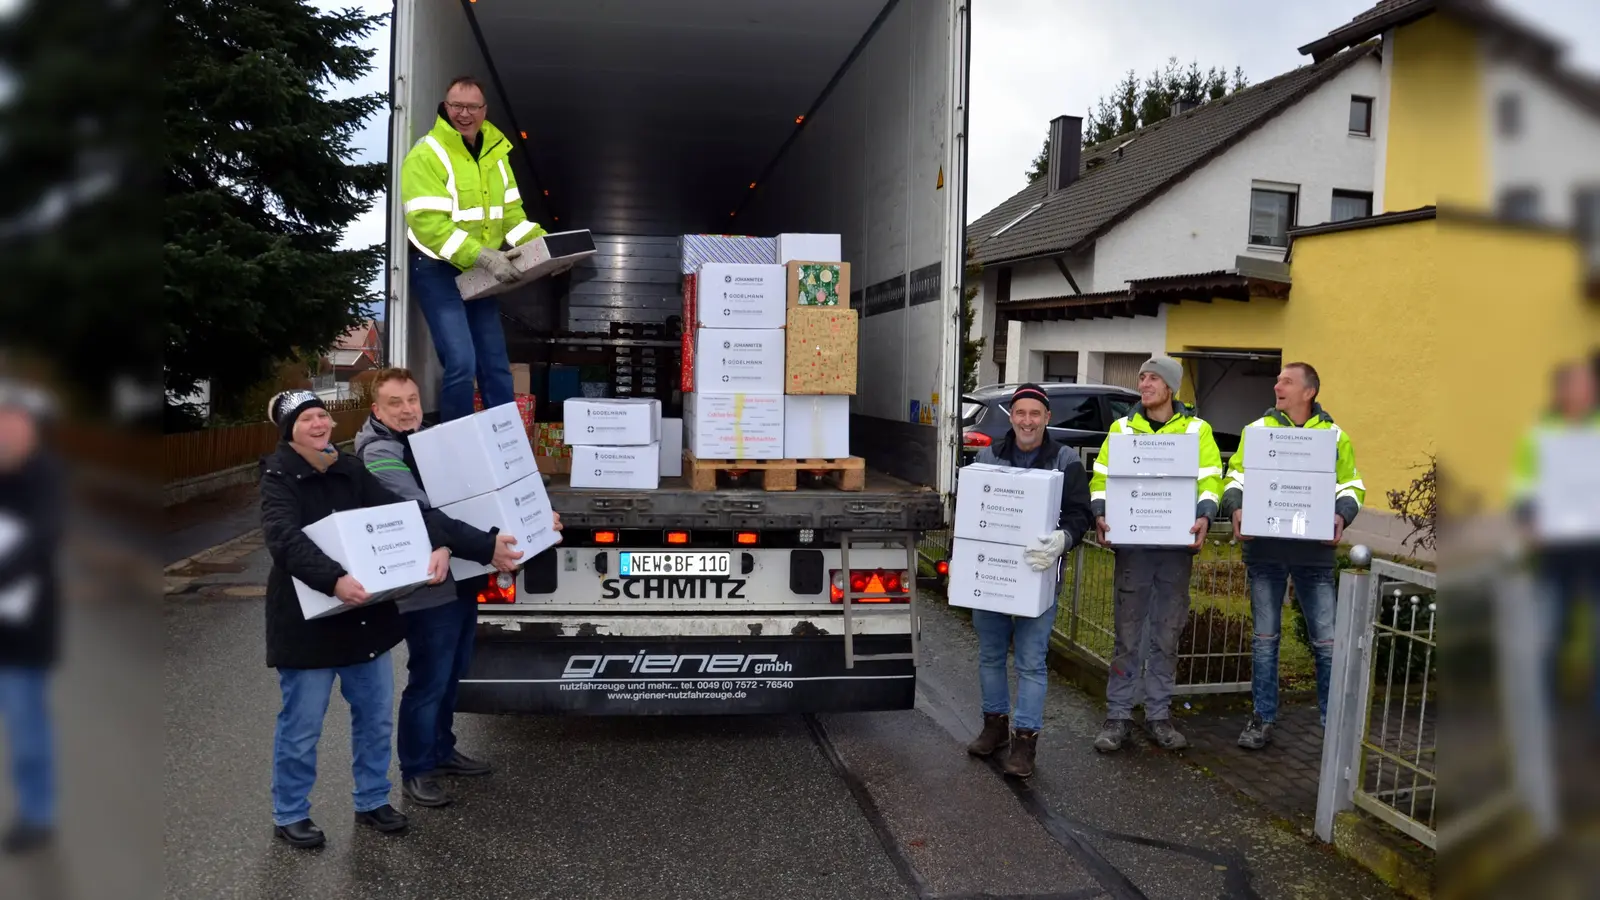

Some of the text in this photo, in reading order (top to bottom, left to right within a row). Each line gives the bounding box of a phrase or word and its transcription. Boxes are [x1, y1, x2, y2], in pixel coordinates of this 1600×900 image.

[994, 487, 1024, 495] JOHANNITER
[376, 520, 403, 530] JOHANNITER
[631, 555, 662, 572] NEW
[675, 555, 694, 572] BF
[699, 555, 727, 572] 110
[988, 556, 1018, 565] JOHANNITER
[602, 578, 746, 599] SCHMITZ
[561, 649, 792, 678] griener gmbh
[560, 682, 625, 691] nutzfahrzeuge
[722, 681, 733, 690] (0)
[607, 691, 747, 701] www.griener-nutzfahrzeuge.de
